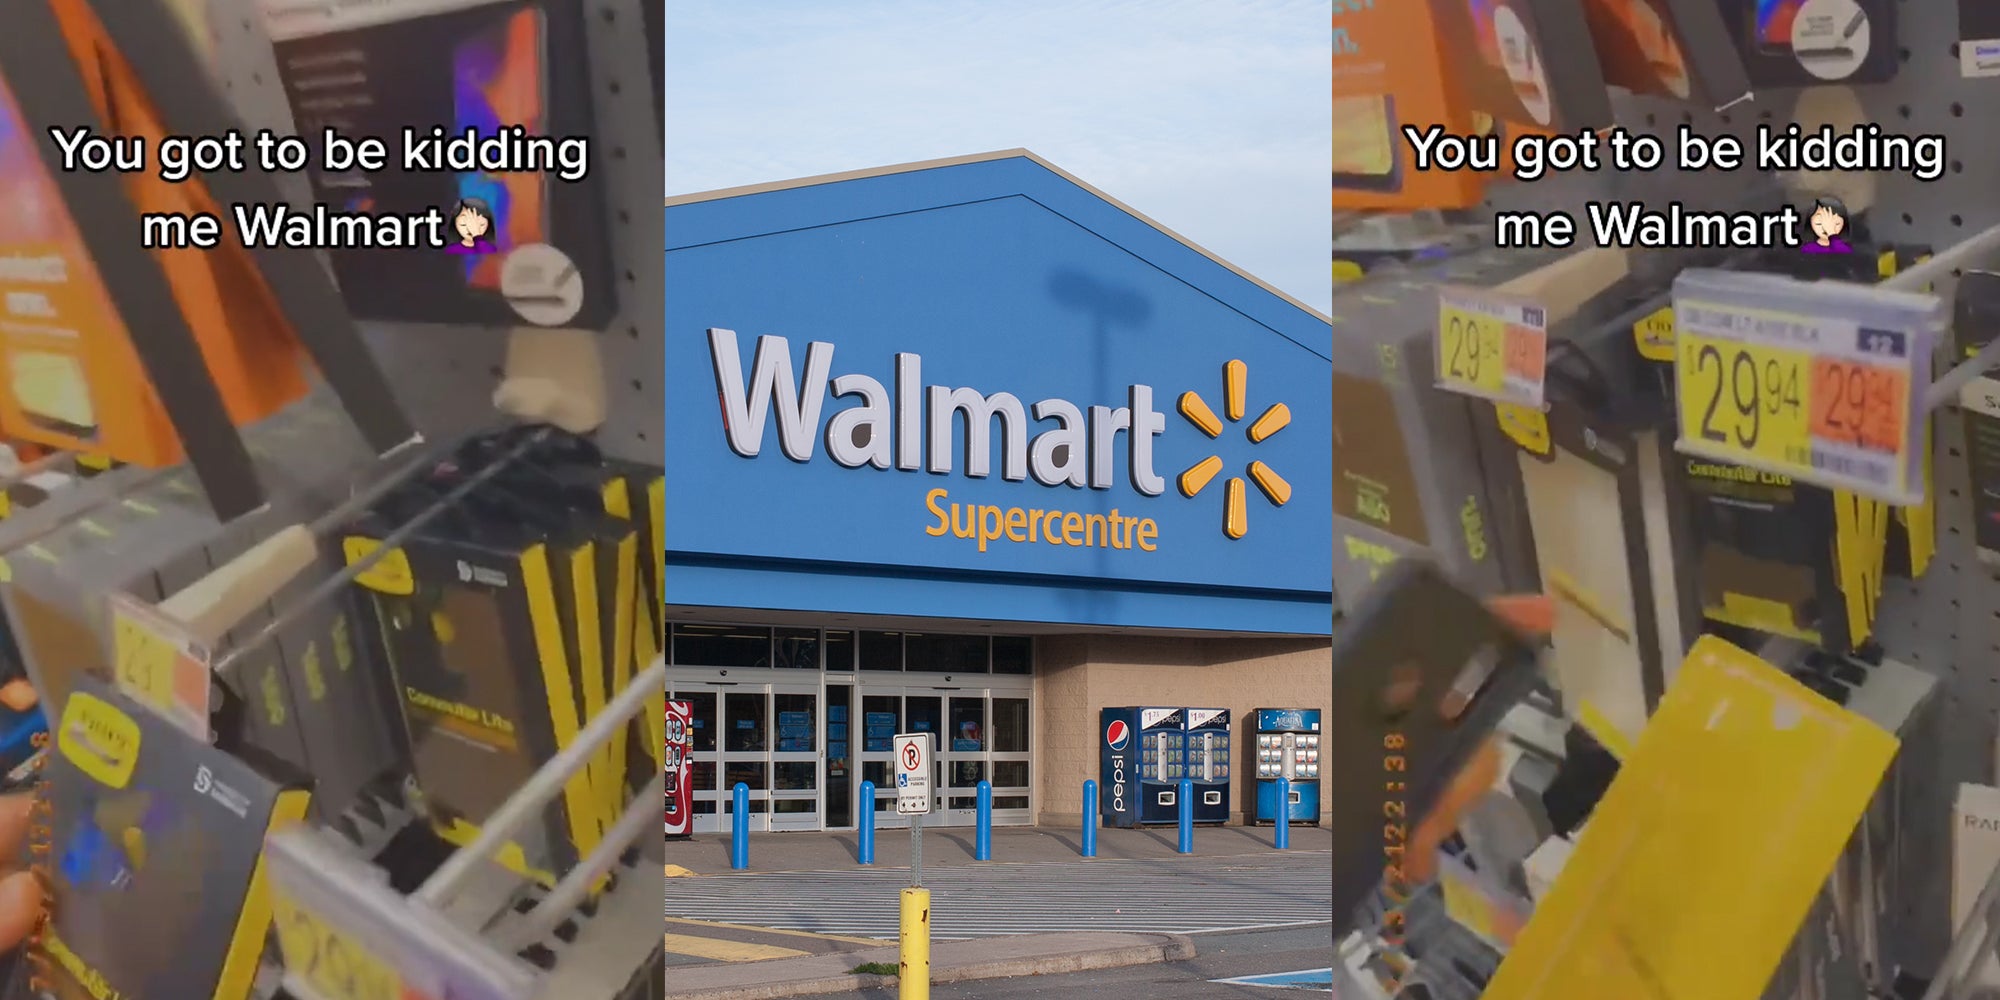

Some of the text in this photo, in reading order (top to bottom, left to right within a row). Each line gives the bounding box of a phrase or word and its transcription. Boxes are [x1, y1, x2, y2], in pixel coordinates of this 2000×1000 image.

[706, 327, 1166, 497] Walmart
[925, 488, 1159, 553] Supercentre
[1112, 754, 1126, 812] pepsi
